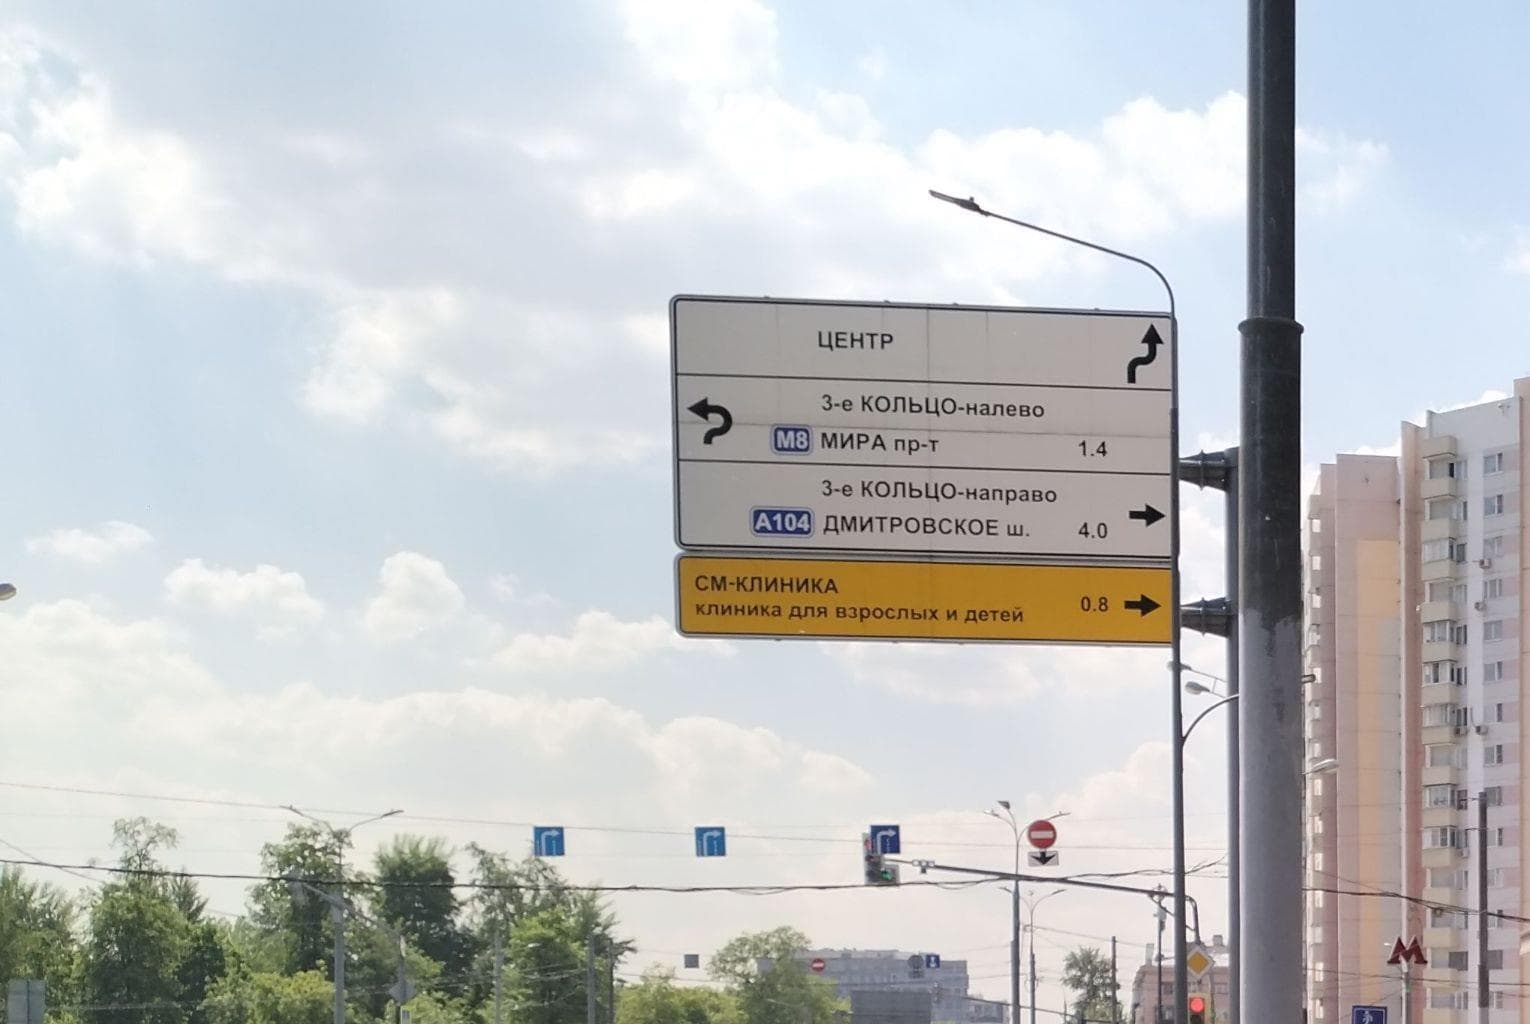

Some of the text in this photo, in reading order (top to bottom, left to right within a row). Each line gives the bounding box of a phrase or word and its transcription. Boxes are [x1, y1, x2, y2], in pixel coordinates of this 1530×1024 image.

[818, 330, 894, 352] ЦЕНТР
[821, 394, 1045, 418] 3-е КОЛЬЦО-налево
[775, 430, 1108, 457] М8 МИРА пр-т 1.4
[821, 479, 1057, 506] 3-е КОЛЬЦО-направо
[753, 512, 1108, 539] А104 ДМИТРОВСКОЕ ш. 4.0
[694, 574, 1109, 613] СМ-КЛИНИКА 0.8
[695, 603, 1024, 624] клиника для взрослых и детей
